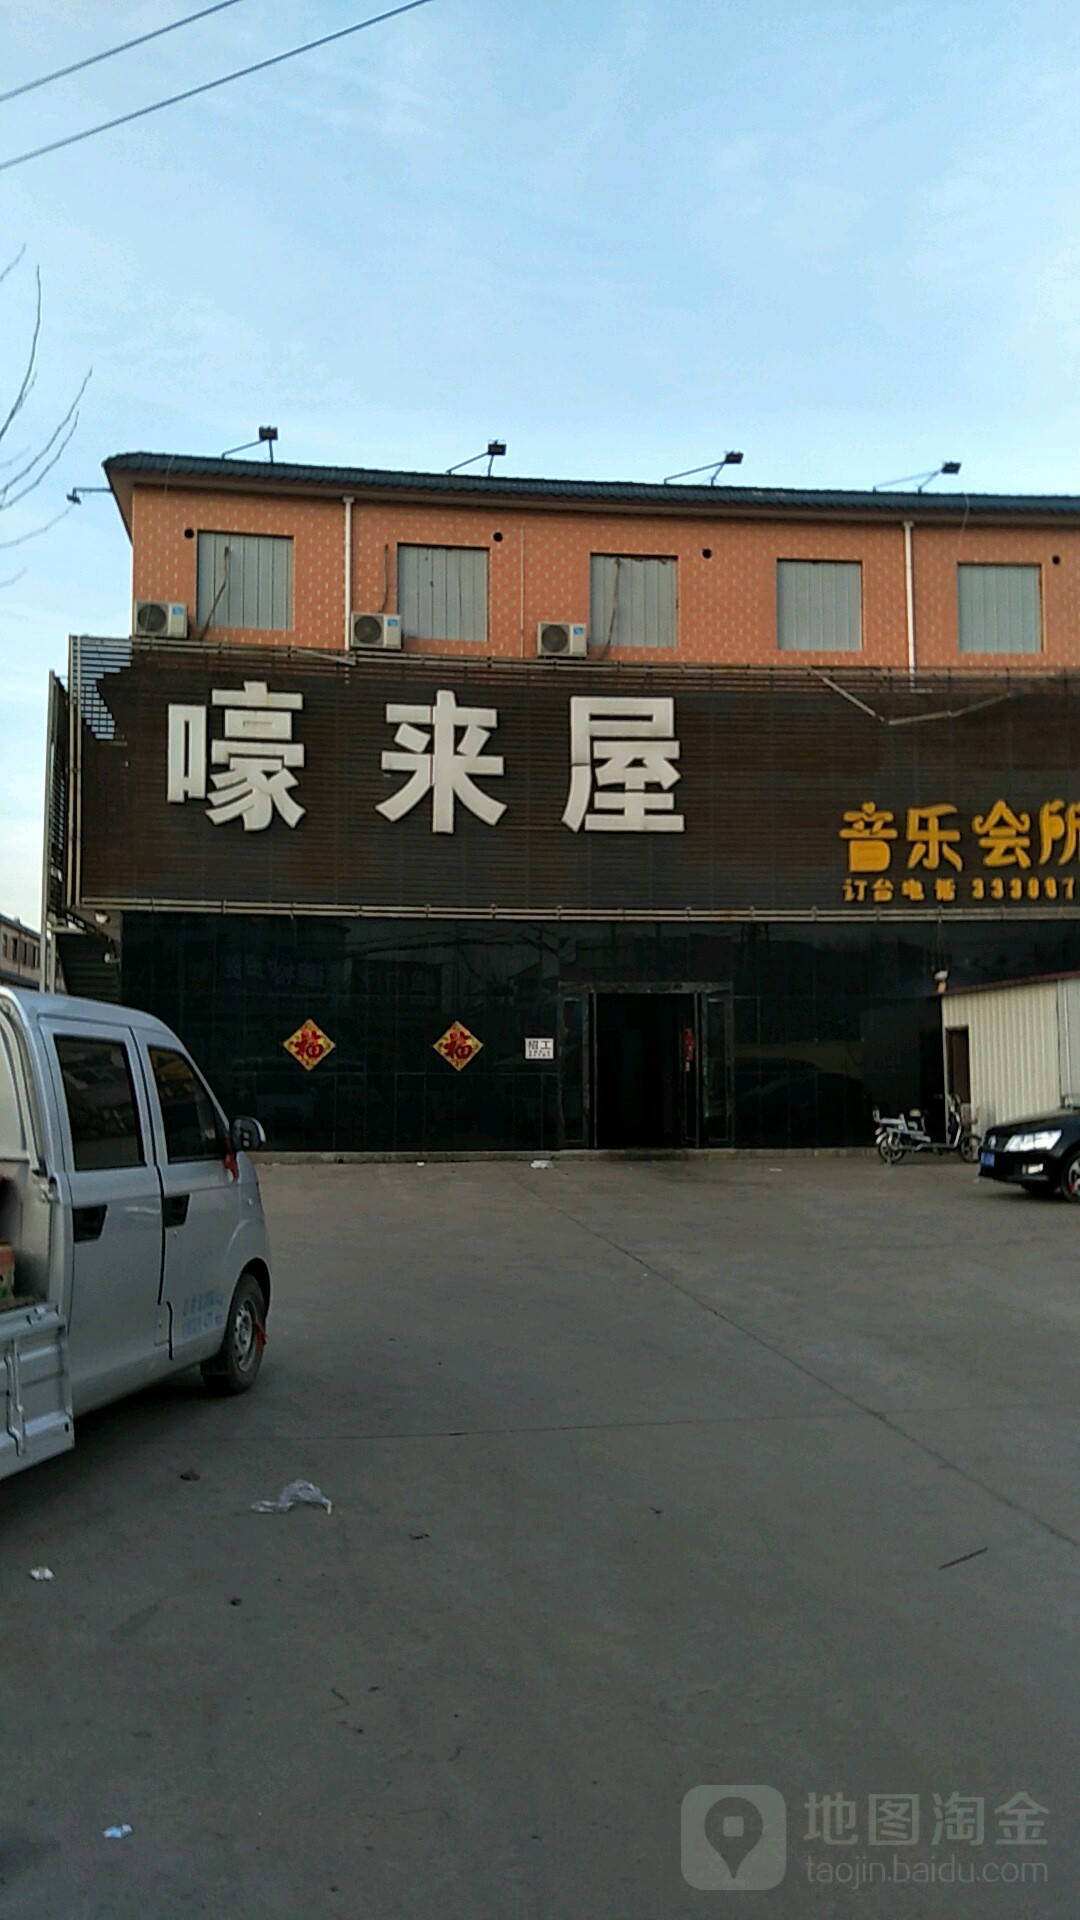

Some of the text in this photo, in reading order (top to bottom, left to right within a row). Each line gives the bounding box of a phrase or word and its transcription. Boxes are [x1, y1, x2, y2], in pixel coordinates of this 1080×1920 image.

[167, 681, 685, 833] 嚎来屋
[839, 799, 1080, 873] 音乐会所
